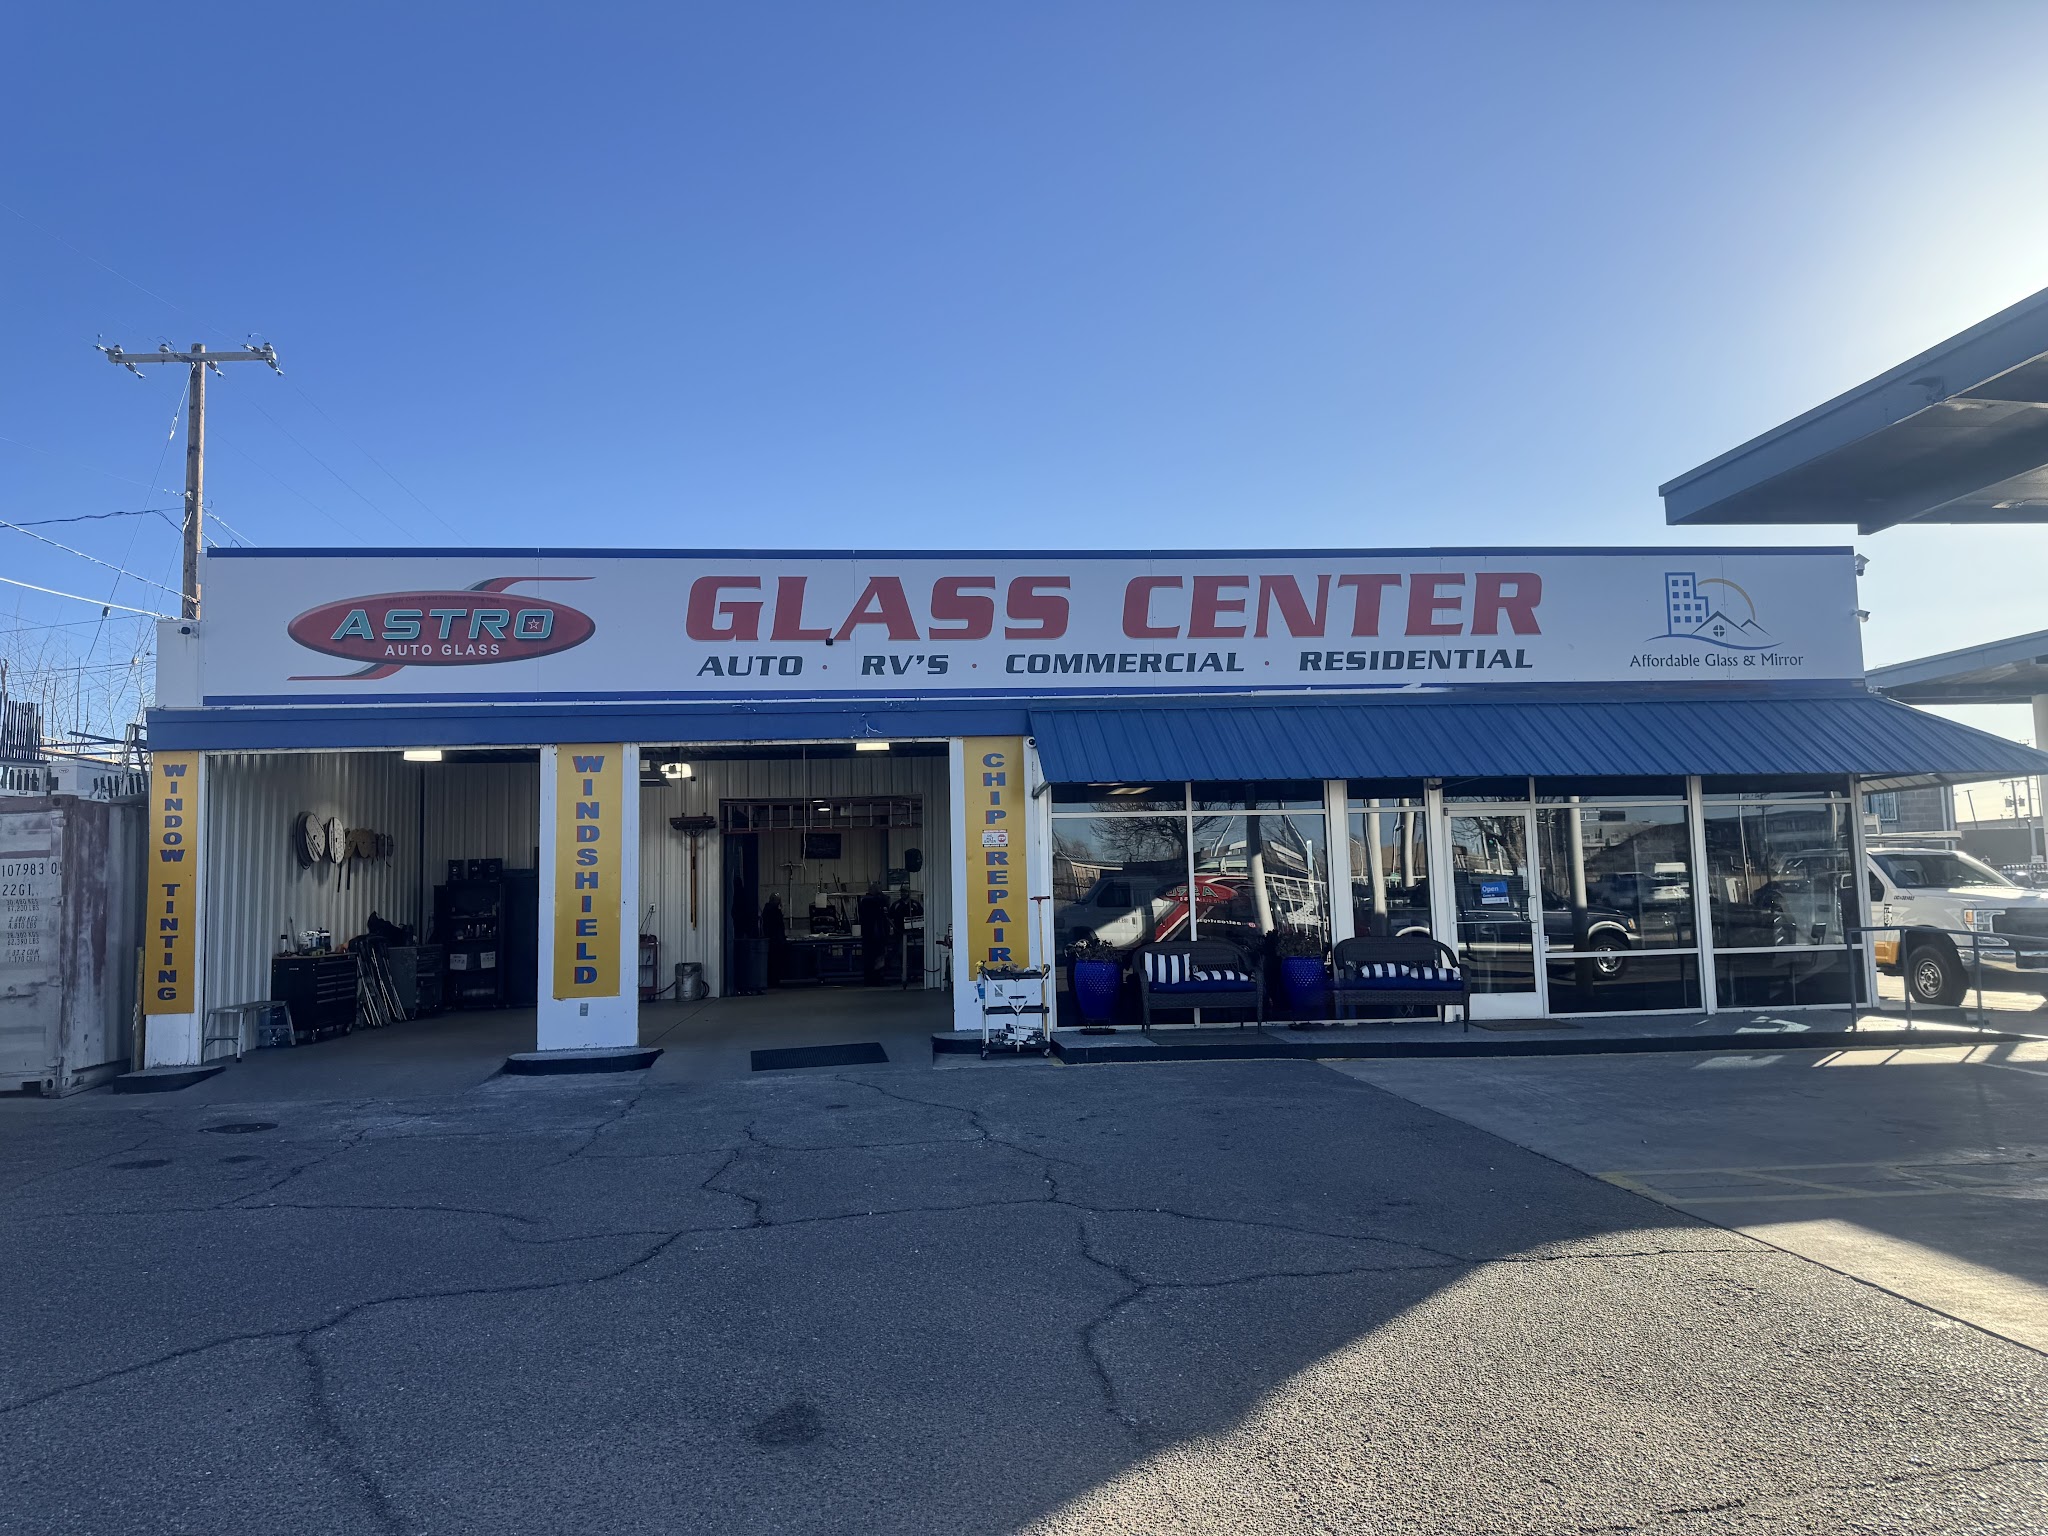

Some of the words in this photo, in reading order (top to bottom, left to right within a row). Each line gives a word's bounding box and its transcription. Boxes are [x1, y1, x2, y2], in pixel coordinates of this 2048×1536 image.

[330, 608, 554, 641] ASTRO
[686, 576, 1070, 641] GLASS
[1122, 572, 1543, 639] CENTER
[384, 644, 433, 656] AUTO
[441, 644, 500, 656] GLASS
[696, 655, 804, 677] AUTO
[861, 654, 949, 676] RV'S
[1005, 652, 1245, 674] COMMERCIAL
[1299, 649, 1534, 671] RESIDENTIAL
[1629, 653, 1700, 667] Affordable
[1705, 653, 1738, 667] Glass
[1743, 654, 1756, 666] &
[1761, 652, 1804, 666] Mirror
[159, 764, 188, 863] WINDOW
[982, 753, 1007, 825] CHIP
[572, 755, 605, 985] WINDSHIELD
[1482, 885, 1499, 893] Open
[985, 851, 1013, 962] REPAIR
[157, 883, 181, 1001] TINTING
